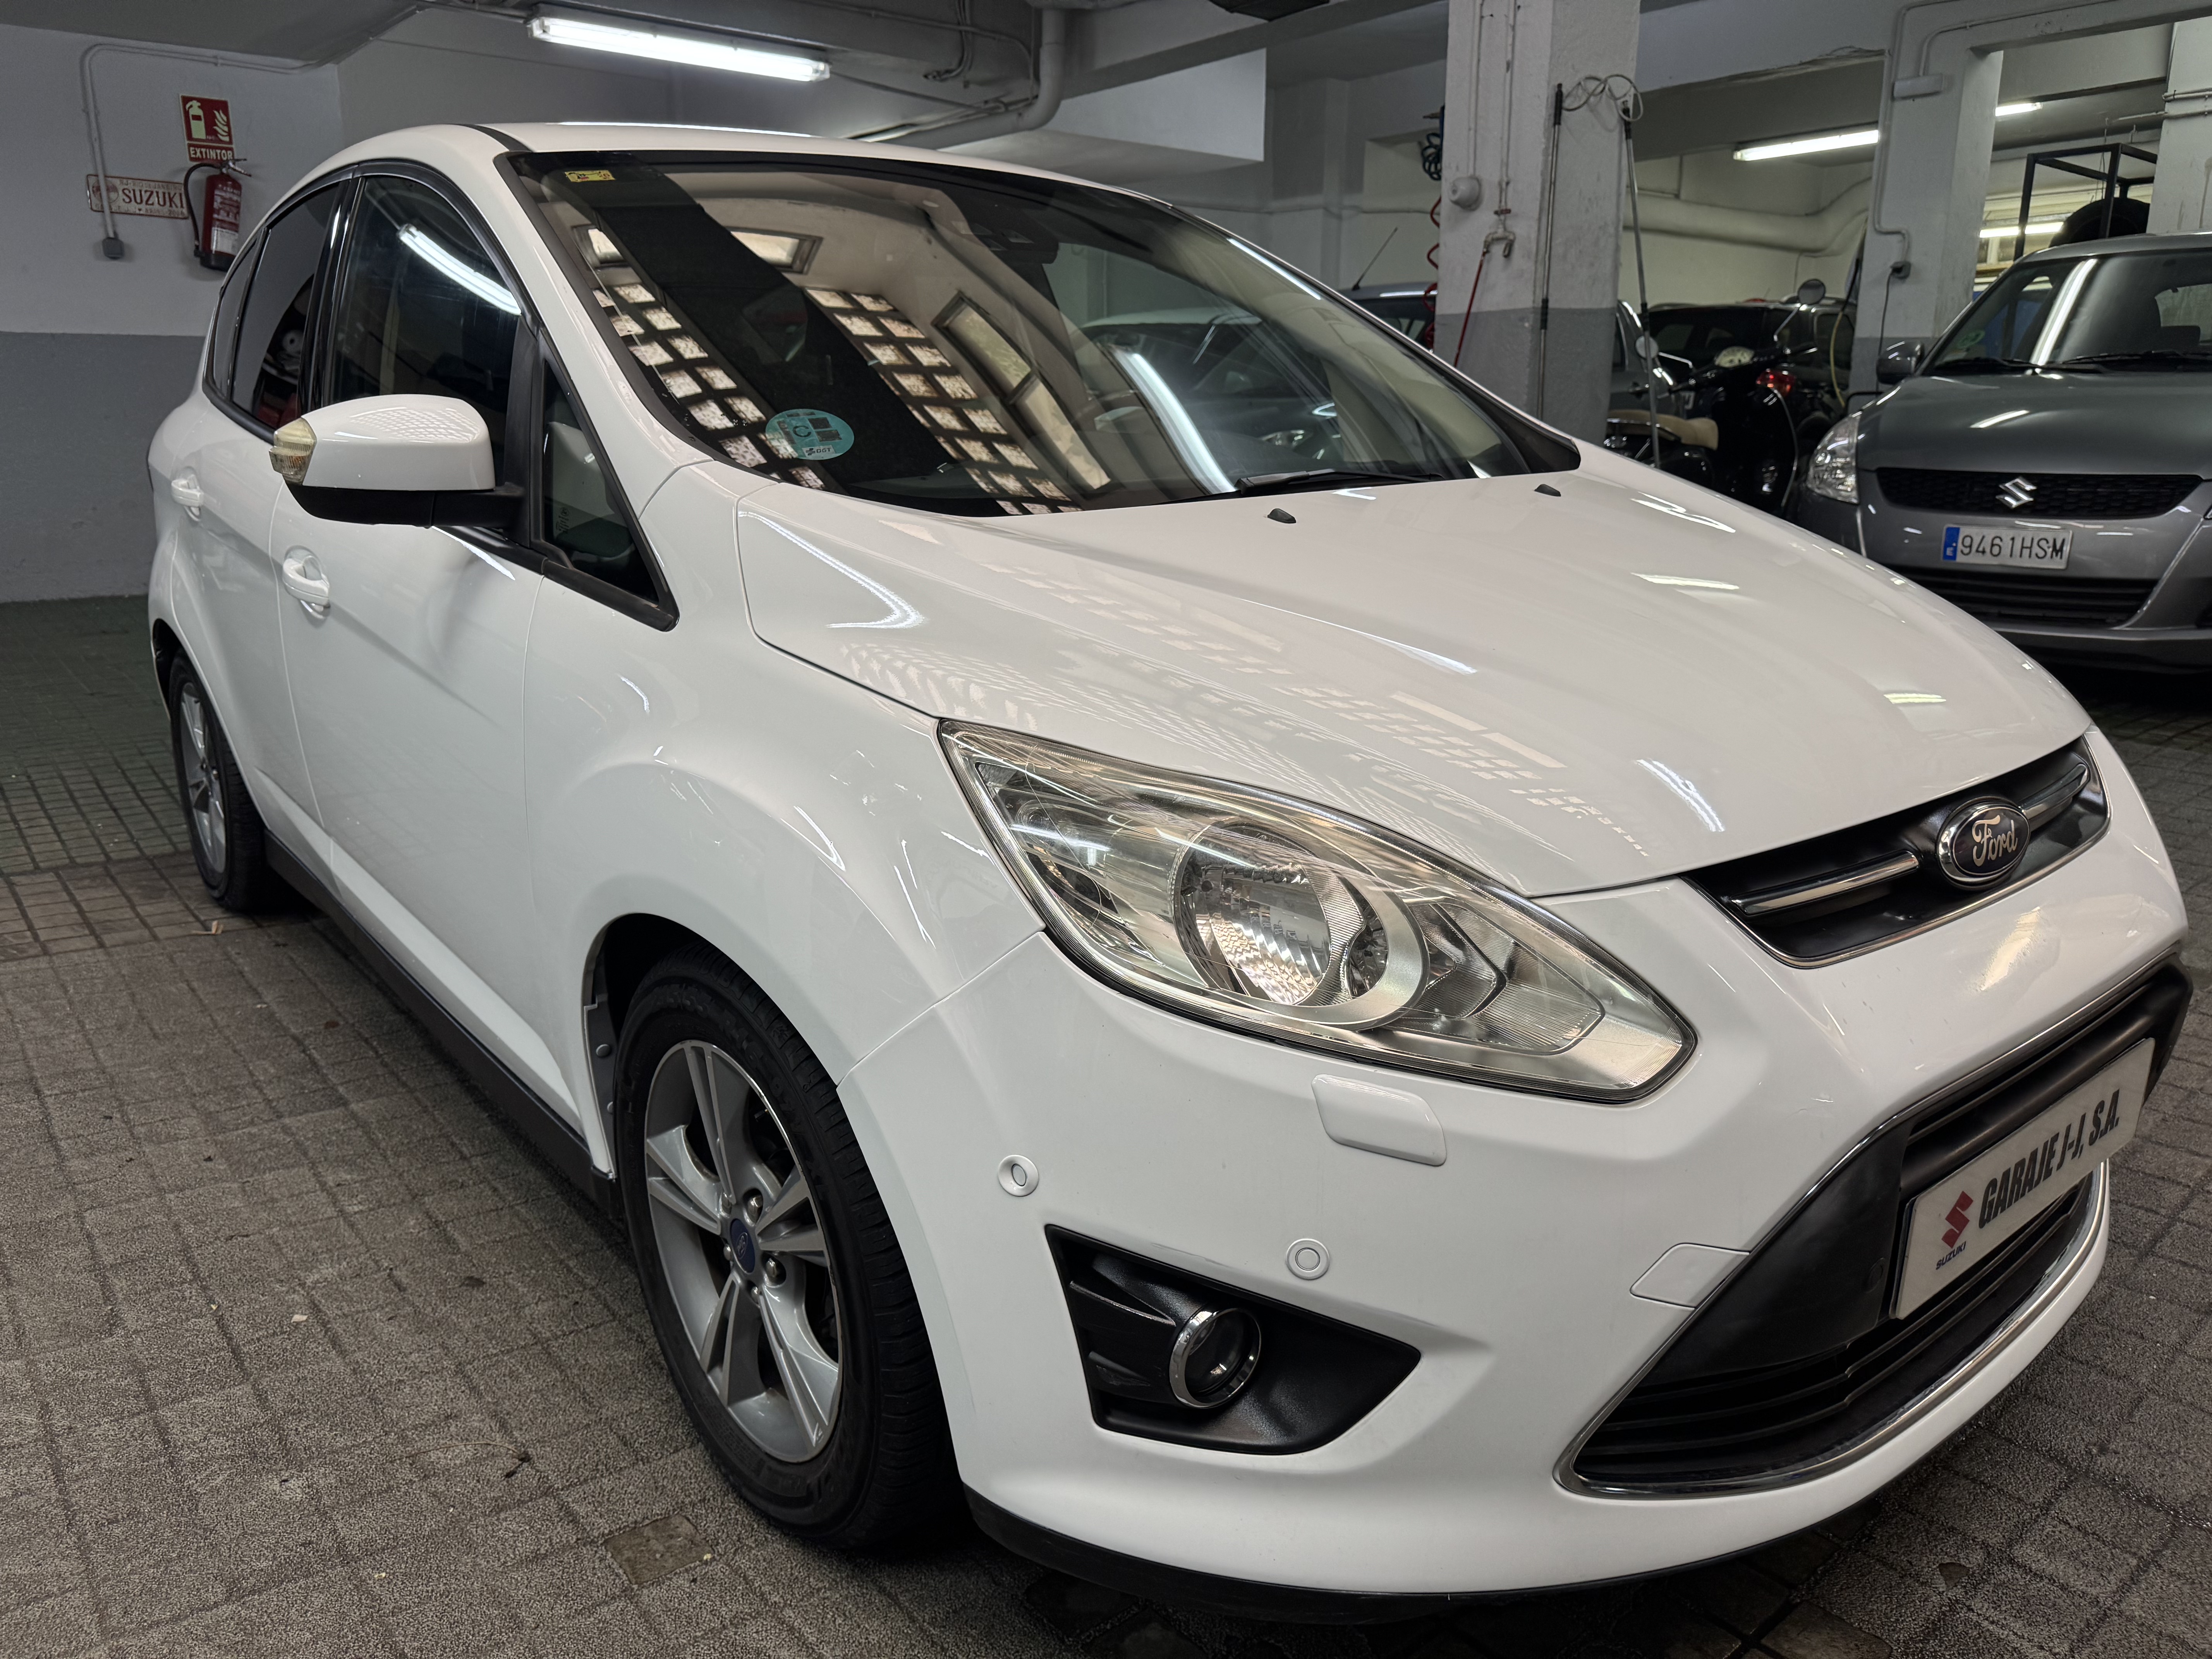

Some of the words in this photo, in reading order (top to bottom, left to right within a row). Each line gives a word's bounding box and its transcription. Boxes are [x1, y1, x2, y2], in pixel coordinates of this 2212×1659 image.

[189, 147, 233, 161] EXTINTOR
[122, 187, 184, 208] SUZUKI
[793, 425, 812, 438] C
[1972, 814, 2018, 867] Ford
[1978, 1132, 2059, 1229] GARAJE
[2088, 1088, 2120, 1146] S.A.
[1936, 1240, 1966, 1270] SUZUKI
